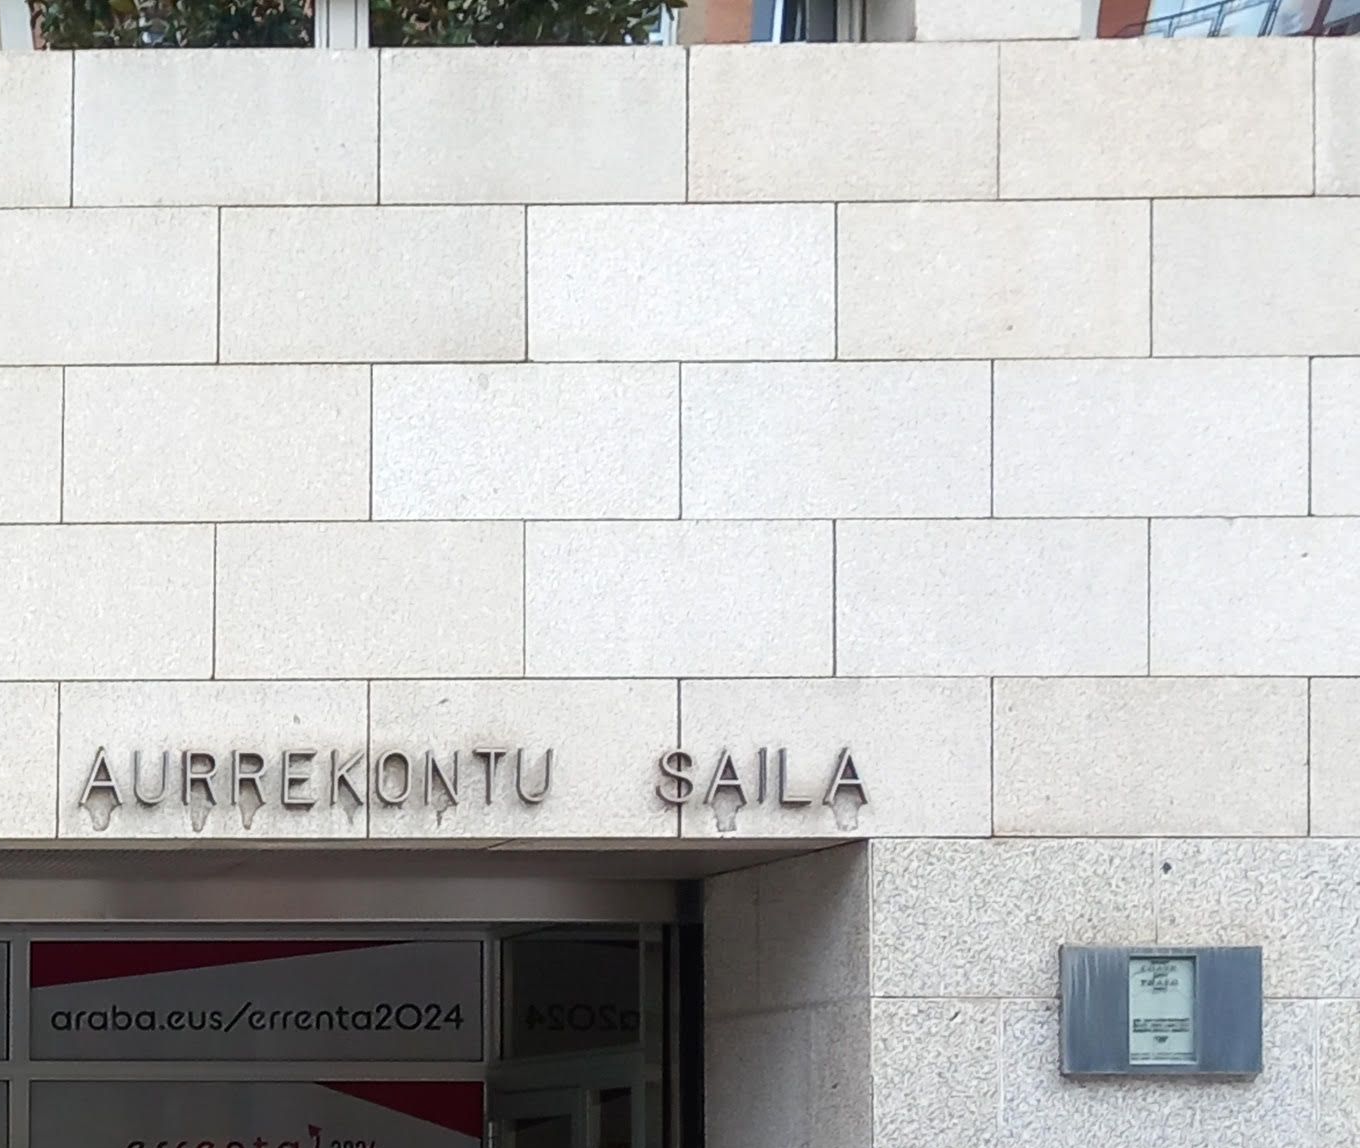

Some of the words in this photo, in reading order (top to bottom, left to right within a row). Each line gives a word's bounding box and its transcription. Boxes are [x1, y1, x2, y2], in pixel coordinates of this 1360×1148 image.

[78, 745, 556, 807] AURREKONTU
[655, 745, 871, 807] SAILA
[50, 1002, 465, 1033] araba.eus/errenta2024
